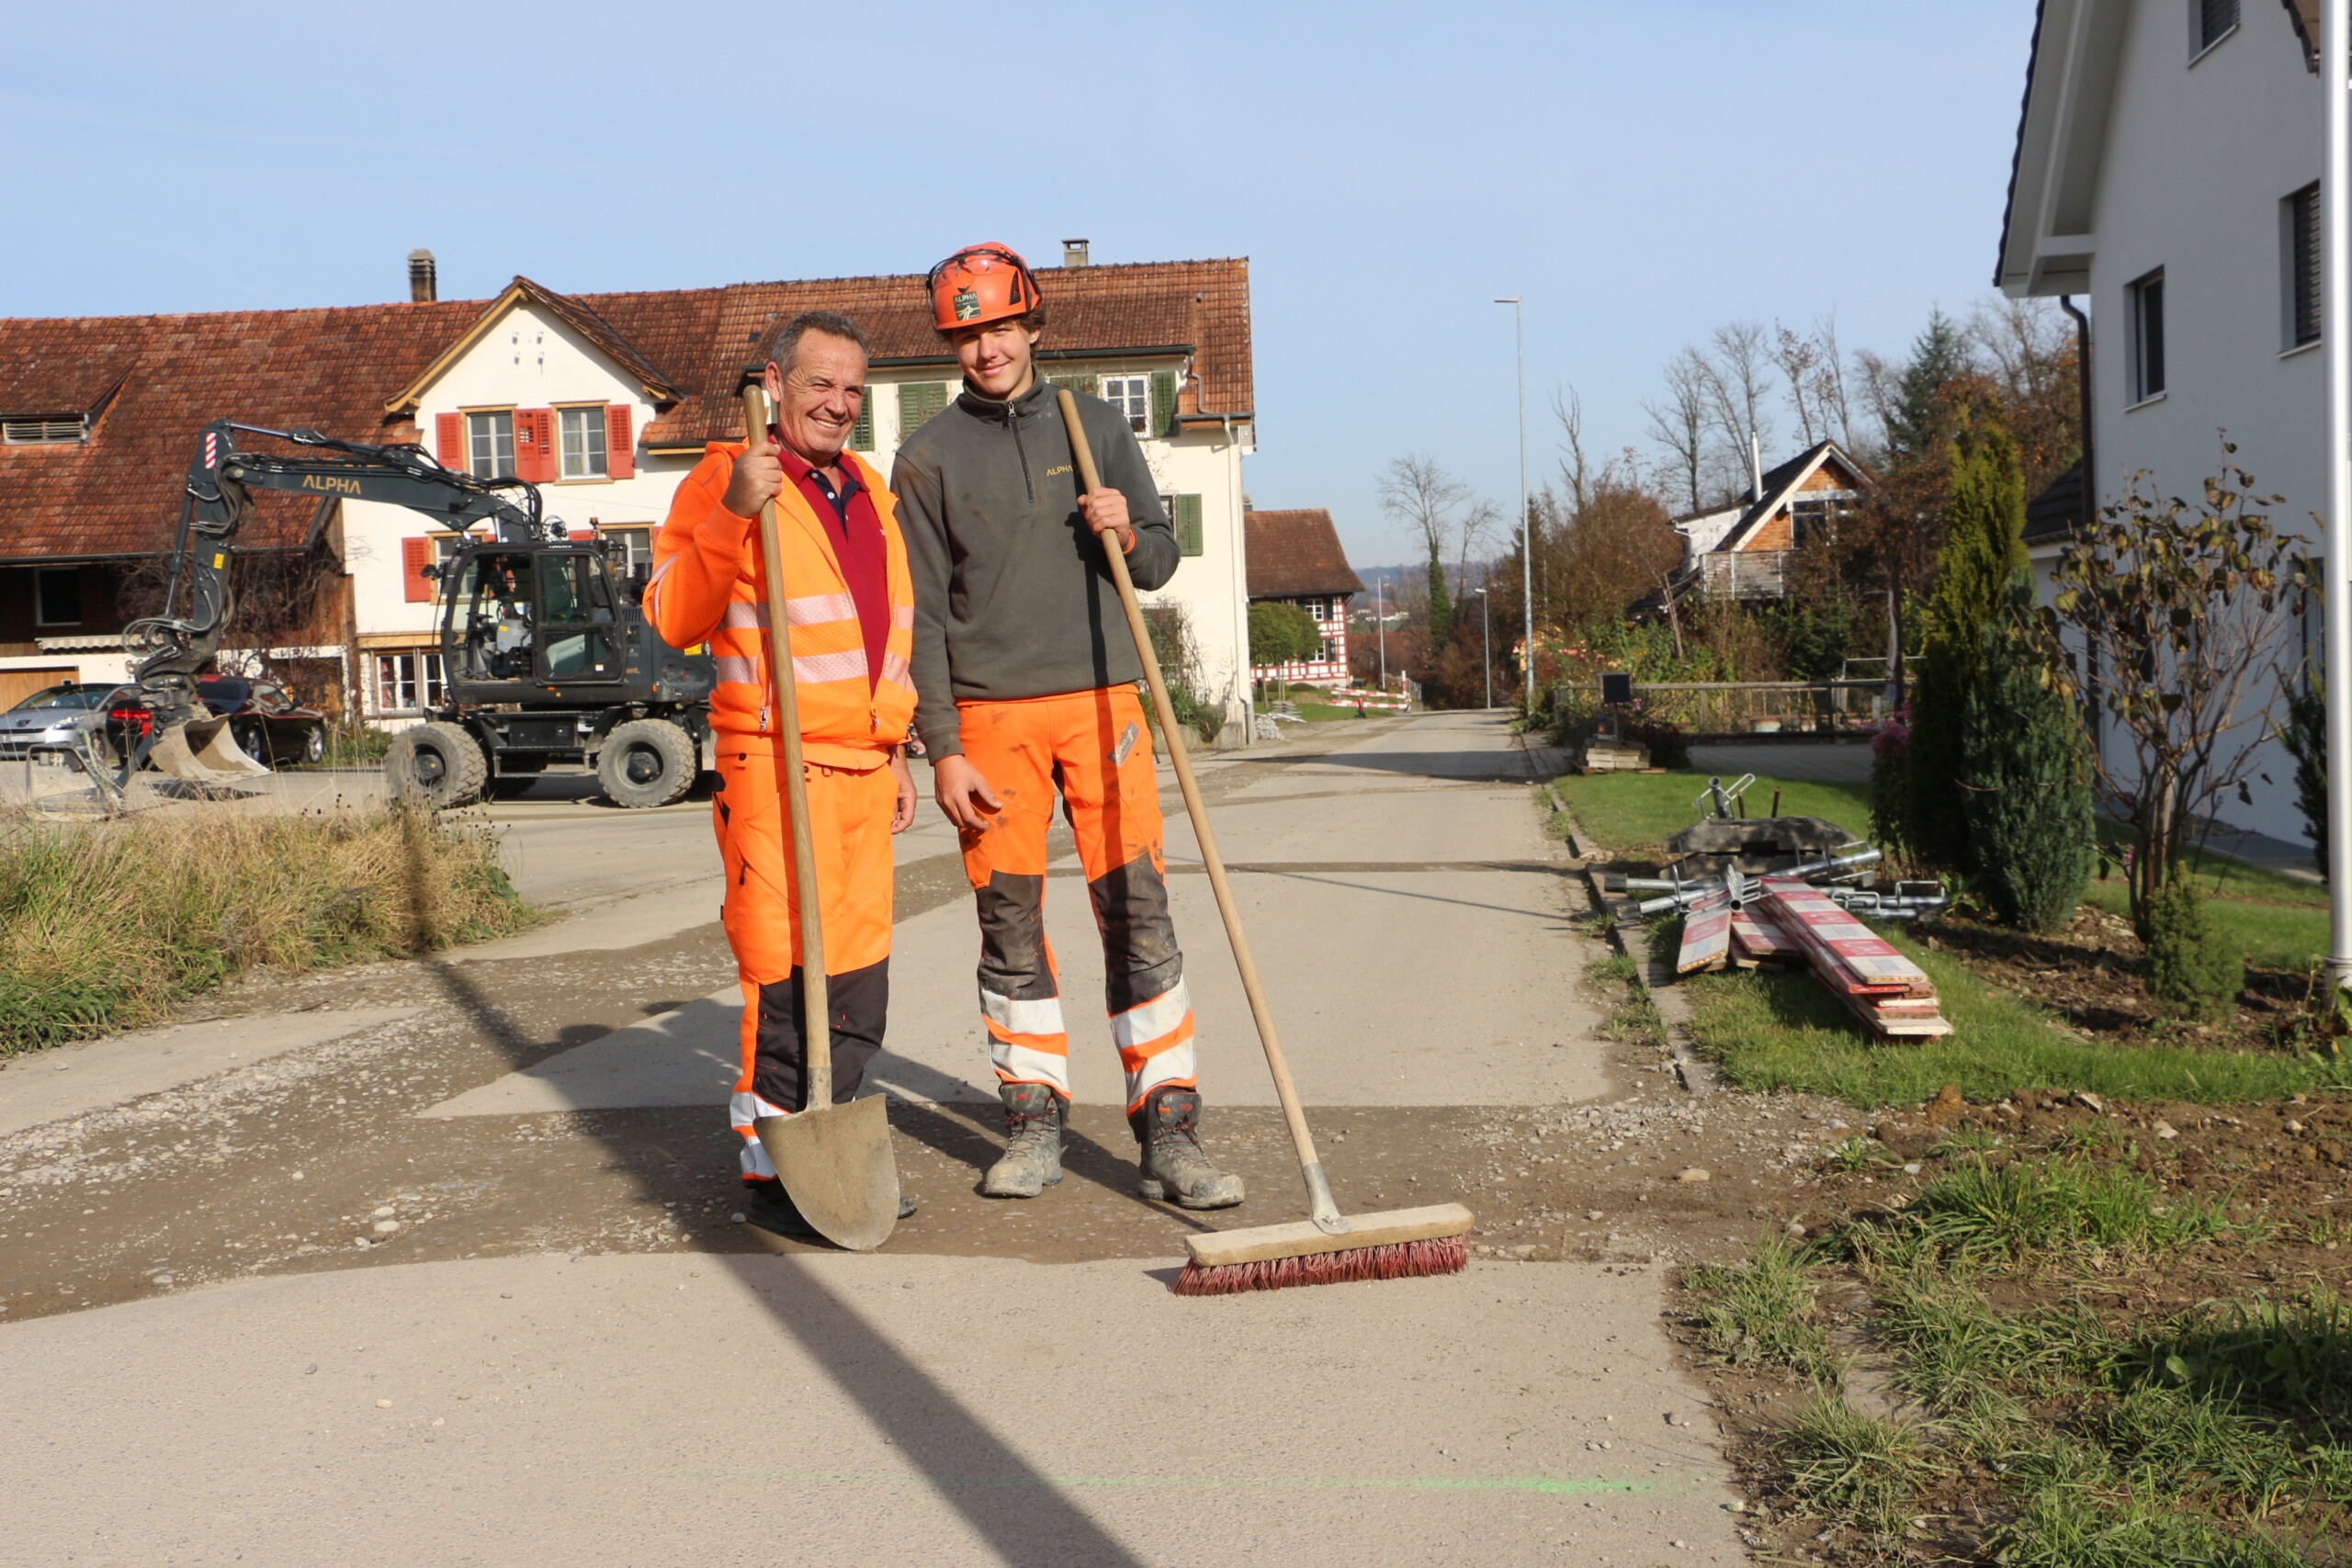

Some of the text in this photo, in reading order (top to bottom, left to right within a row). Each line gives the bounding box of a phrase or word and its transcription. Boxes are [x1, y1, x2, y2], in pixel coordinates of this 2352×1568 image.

[955, 292, 978, 304] ALPHA
[1046, 465, 1074, 477] ALPHA
[301, 474, 361, 495] ALPHA
